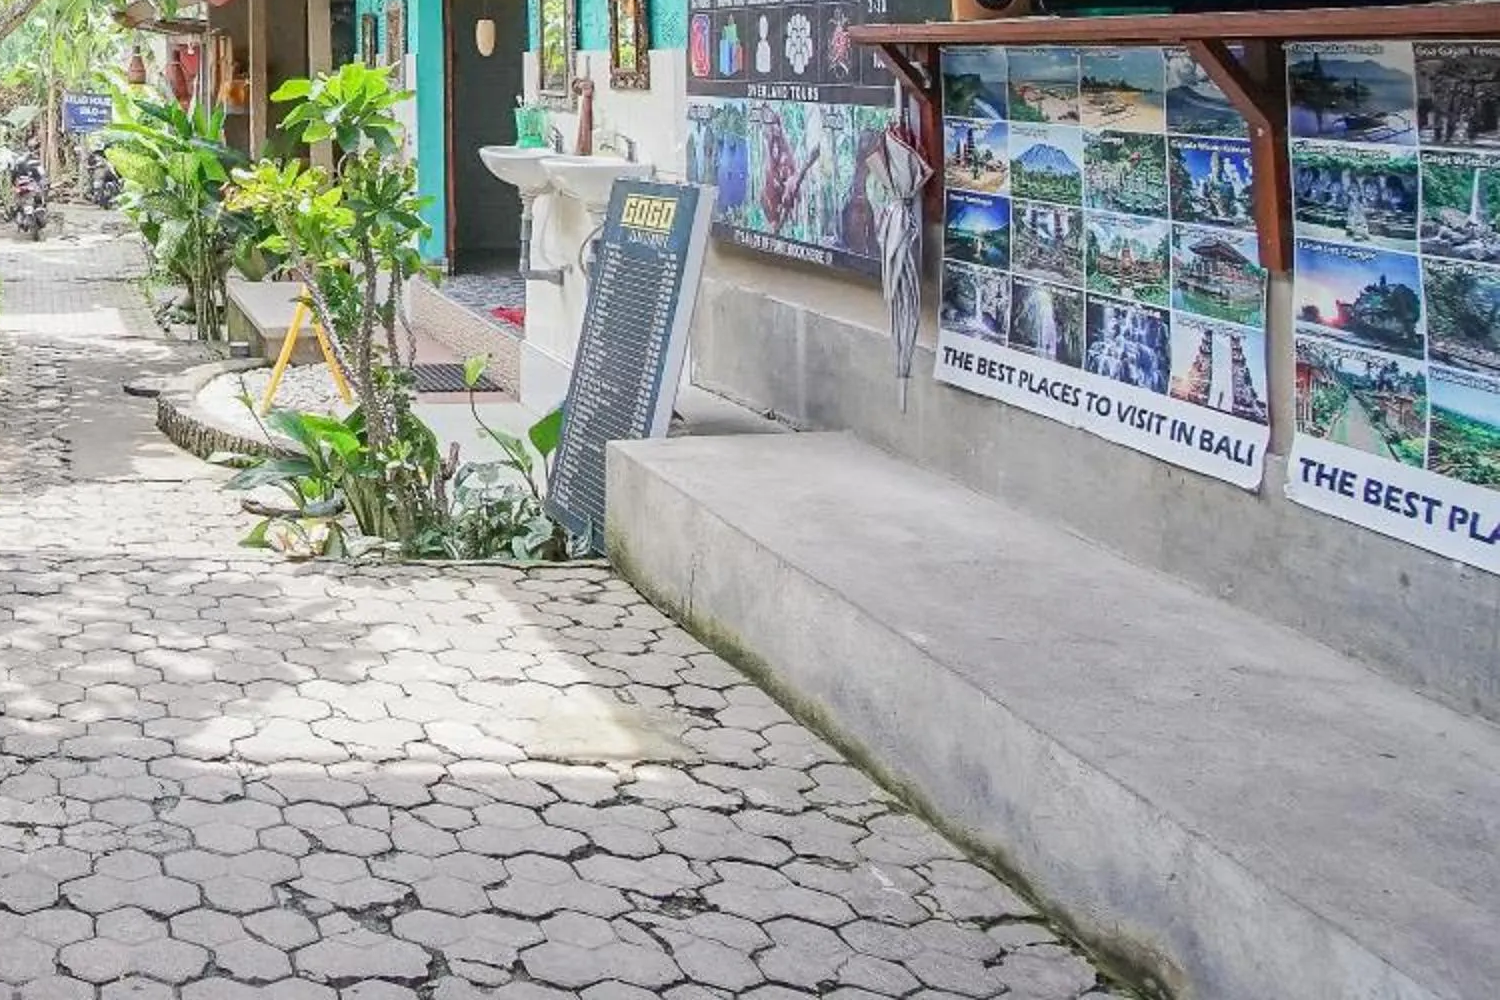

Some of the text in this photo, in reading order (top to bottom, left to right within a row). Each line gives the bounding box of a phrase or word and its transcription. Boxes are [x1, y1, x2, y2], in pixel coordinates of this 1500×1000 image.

[621, 197, 677, 229] GOGO
[943, 346, 1256, 467] THE BEST PLACES TO VISIT IN BALI
[1299, 457, 1358, 499] THE
[1363, 476, 1443, 526] BEST
